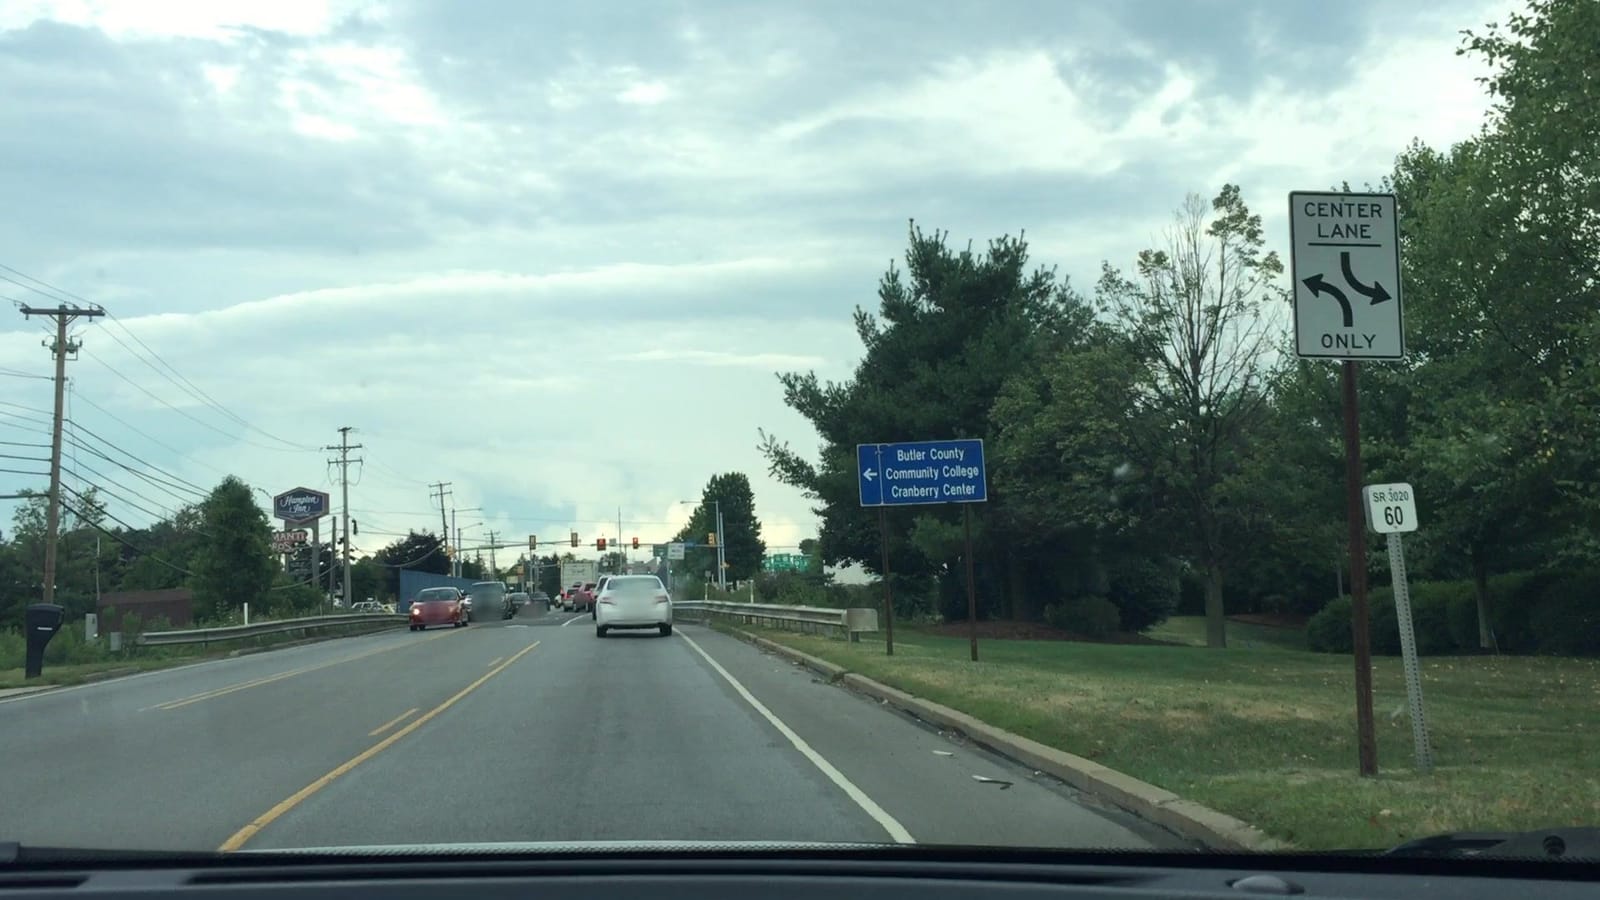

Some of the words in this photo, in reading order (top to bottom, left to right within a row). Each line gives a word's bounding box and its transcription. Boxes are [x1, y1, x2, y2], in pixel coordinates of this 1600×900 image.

[1304, 202, 1382, 218] CENTER
[1317, 223, 1372, 239] LANE
[1321, 333, 1376, 349] ONLY
[897, 449, 926, 461] Butler
[930, 447, 964, 461] County
[885, 466, 938, 481] Community
[942, 465, 979, 479] College
[891, 484, 939, 499] Cranberry
[943, 483, 975, 496] Center
[1372, 492, 1386, 502] SR
[1388, 491, 1409, 502] 3020
[1384, 506, 1403, 525] 60
